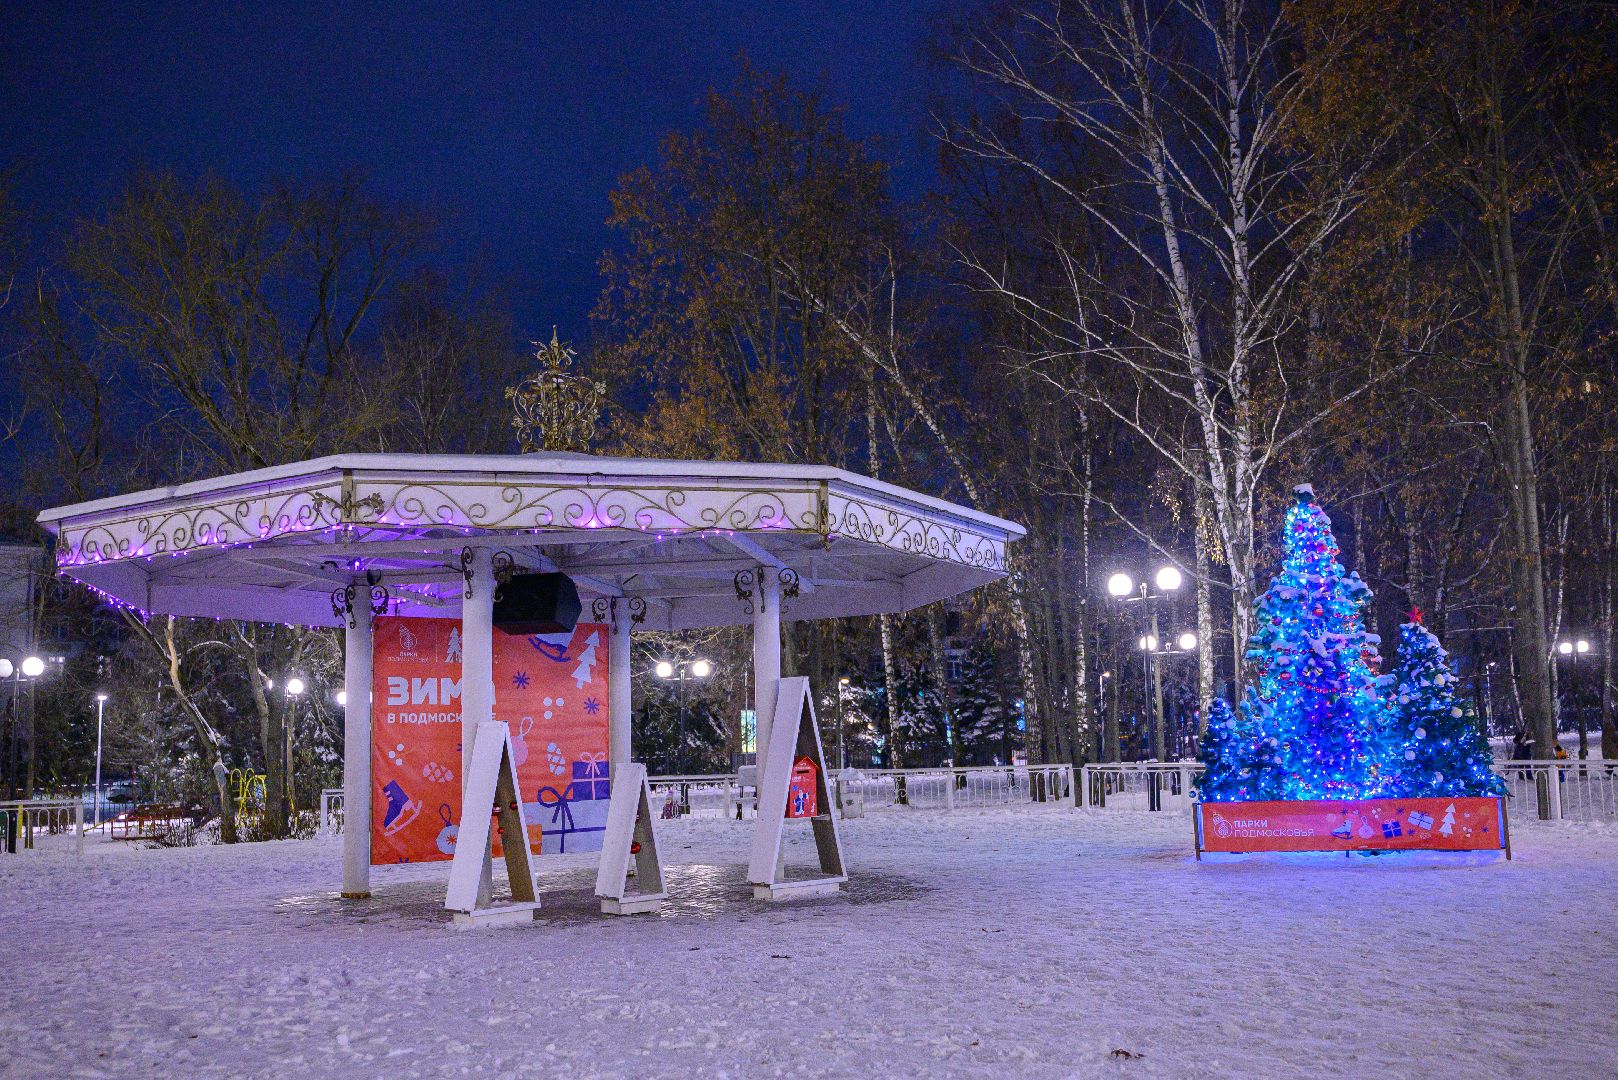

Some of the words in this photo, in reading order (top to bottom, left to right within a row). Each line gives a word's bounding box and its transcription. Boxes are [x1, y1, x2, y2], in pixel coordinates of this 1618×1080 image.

[387, 676, 497, 706] ЗИМ
[387, 713, 396, 724] В
[400, 712, 497, 726] ПОДМОСК
[1234, 820, 1268, 828] ПАРКИ
[1234, 829, 1315, 838] ПОДМОСКОВЬЯ
